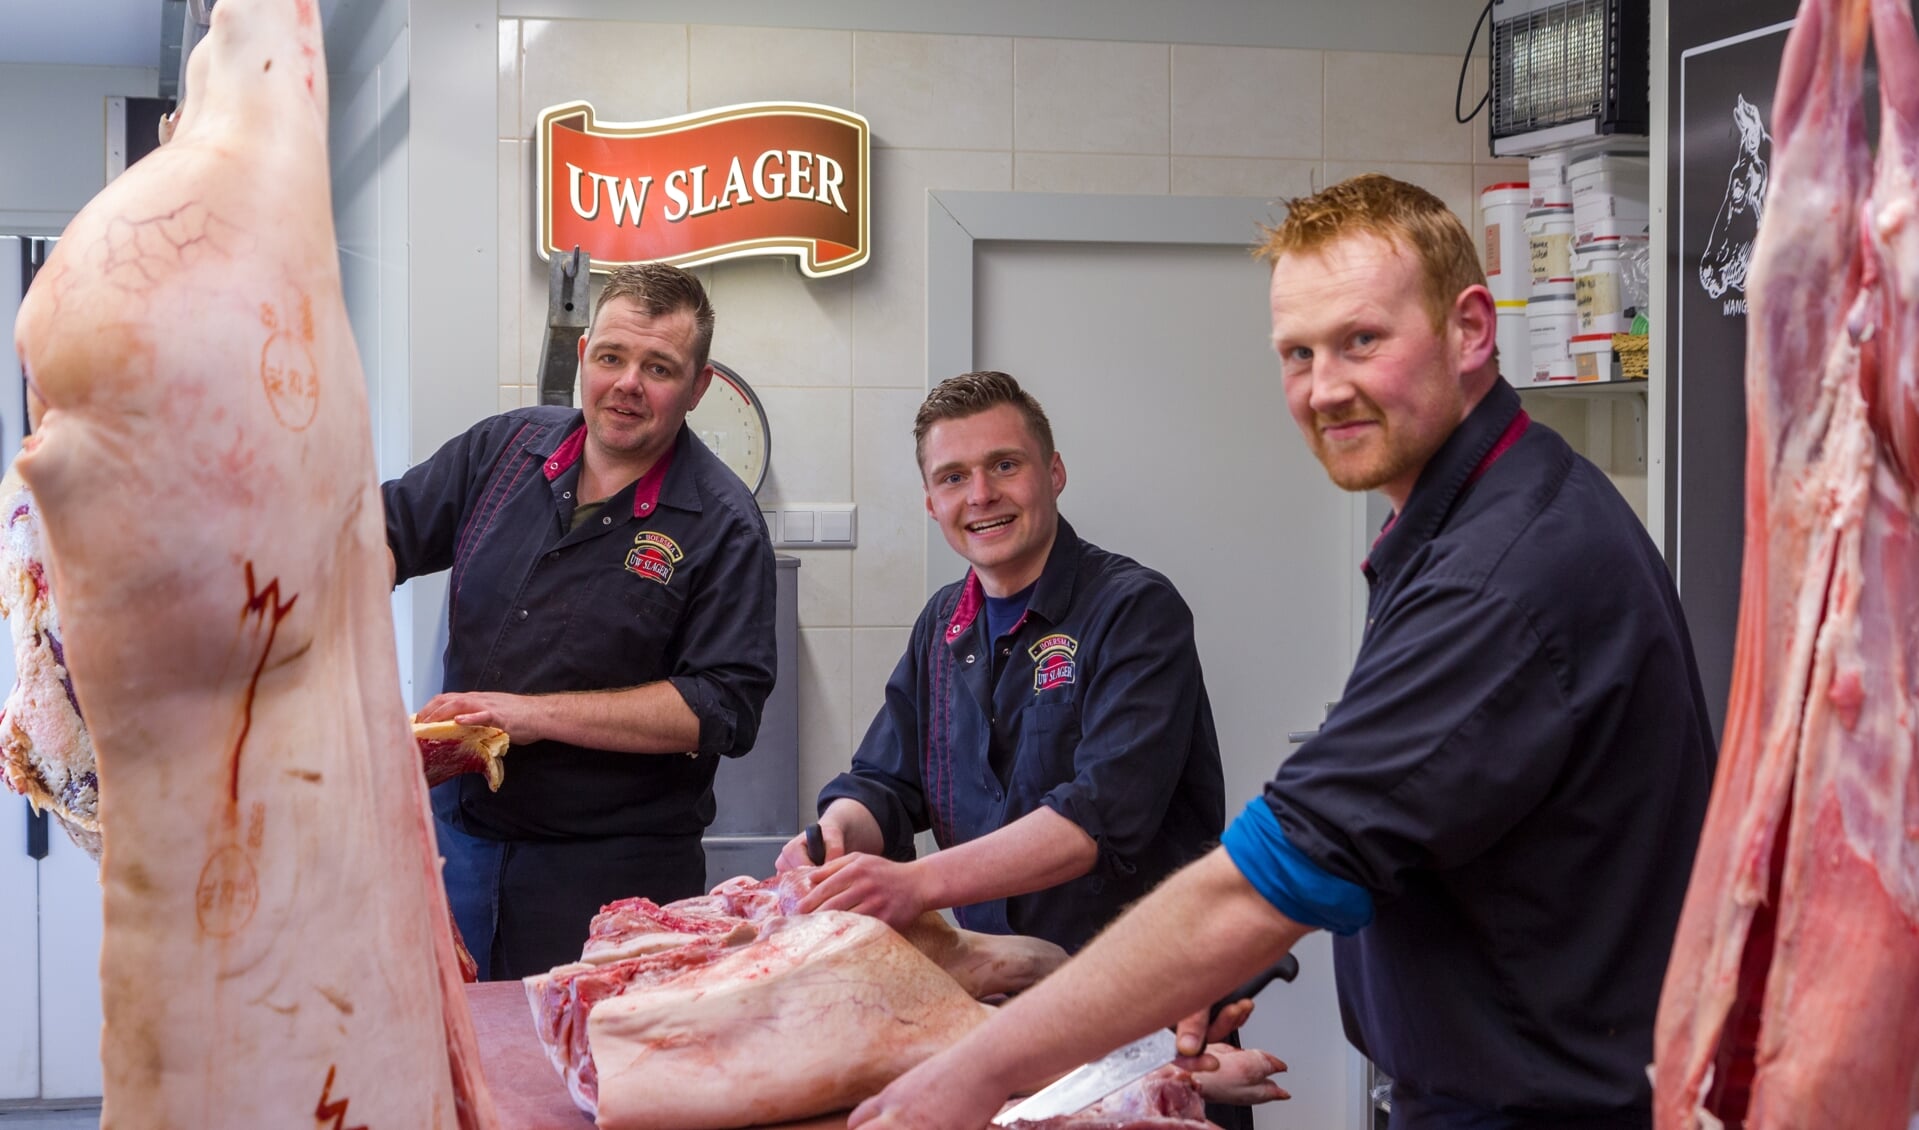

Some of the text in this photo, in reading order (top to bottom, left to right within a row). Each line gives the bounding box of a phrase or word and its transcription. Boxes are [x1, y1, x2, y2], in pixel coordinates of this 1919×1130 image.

[566, 150, 848, 228] UW SLAGER
[630, 554, 668, 578] UW SLAGER
[1038, 666, 1072, 684] UW SLAGER
